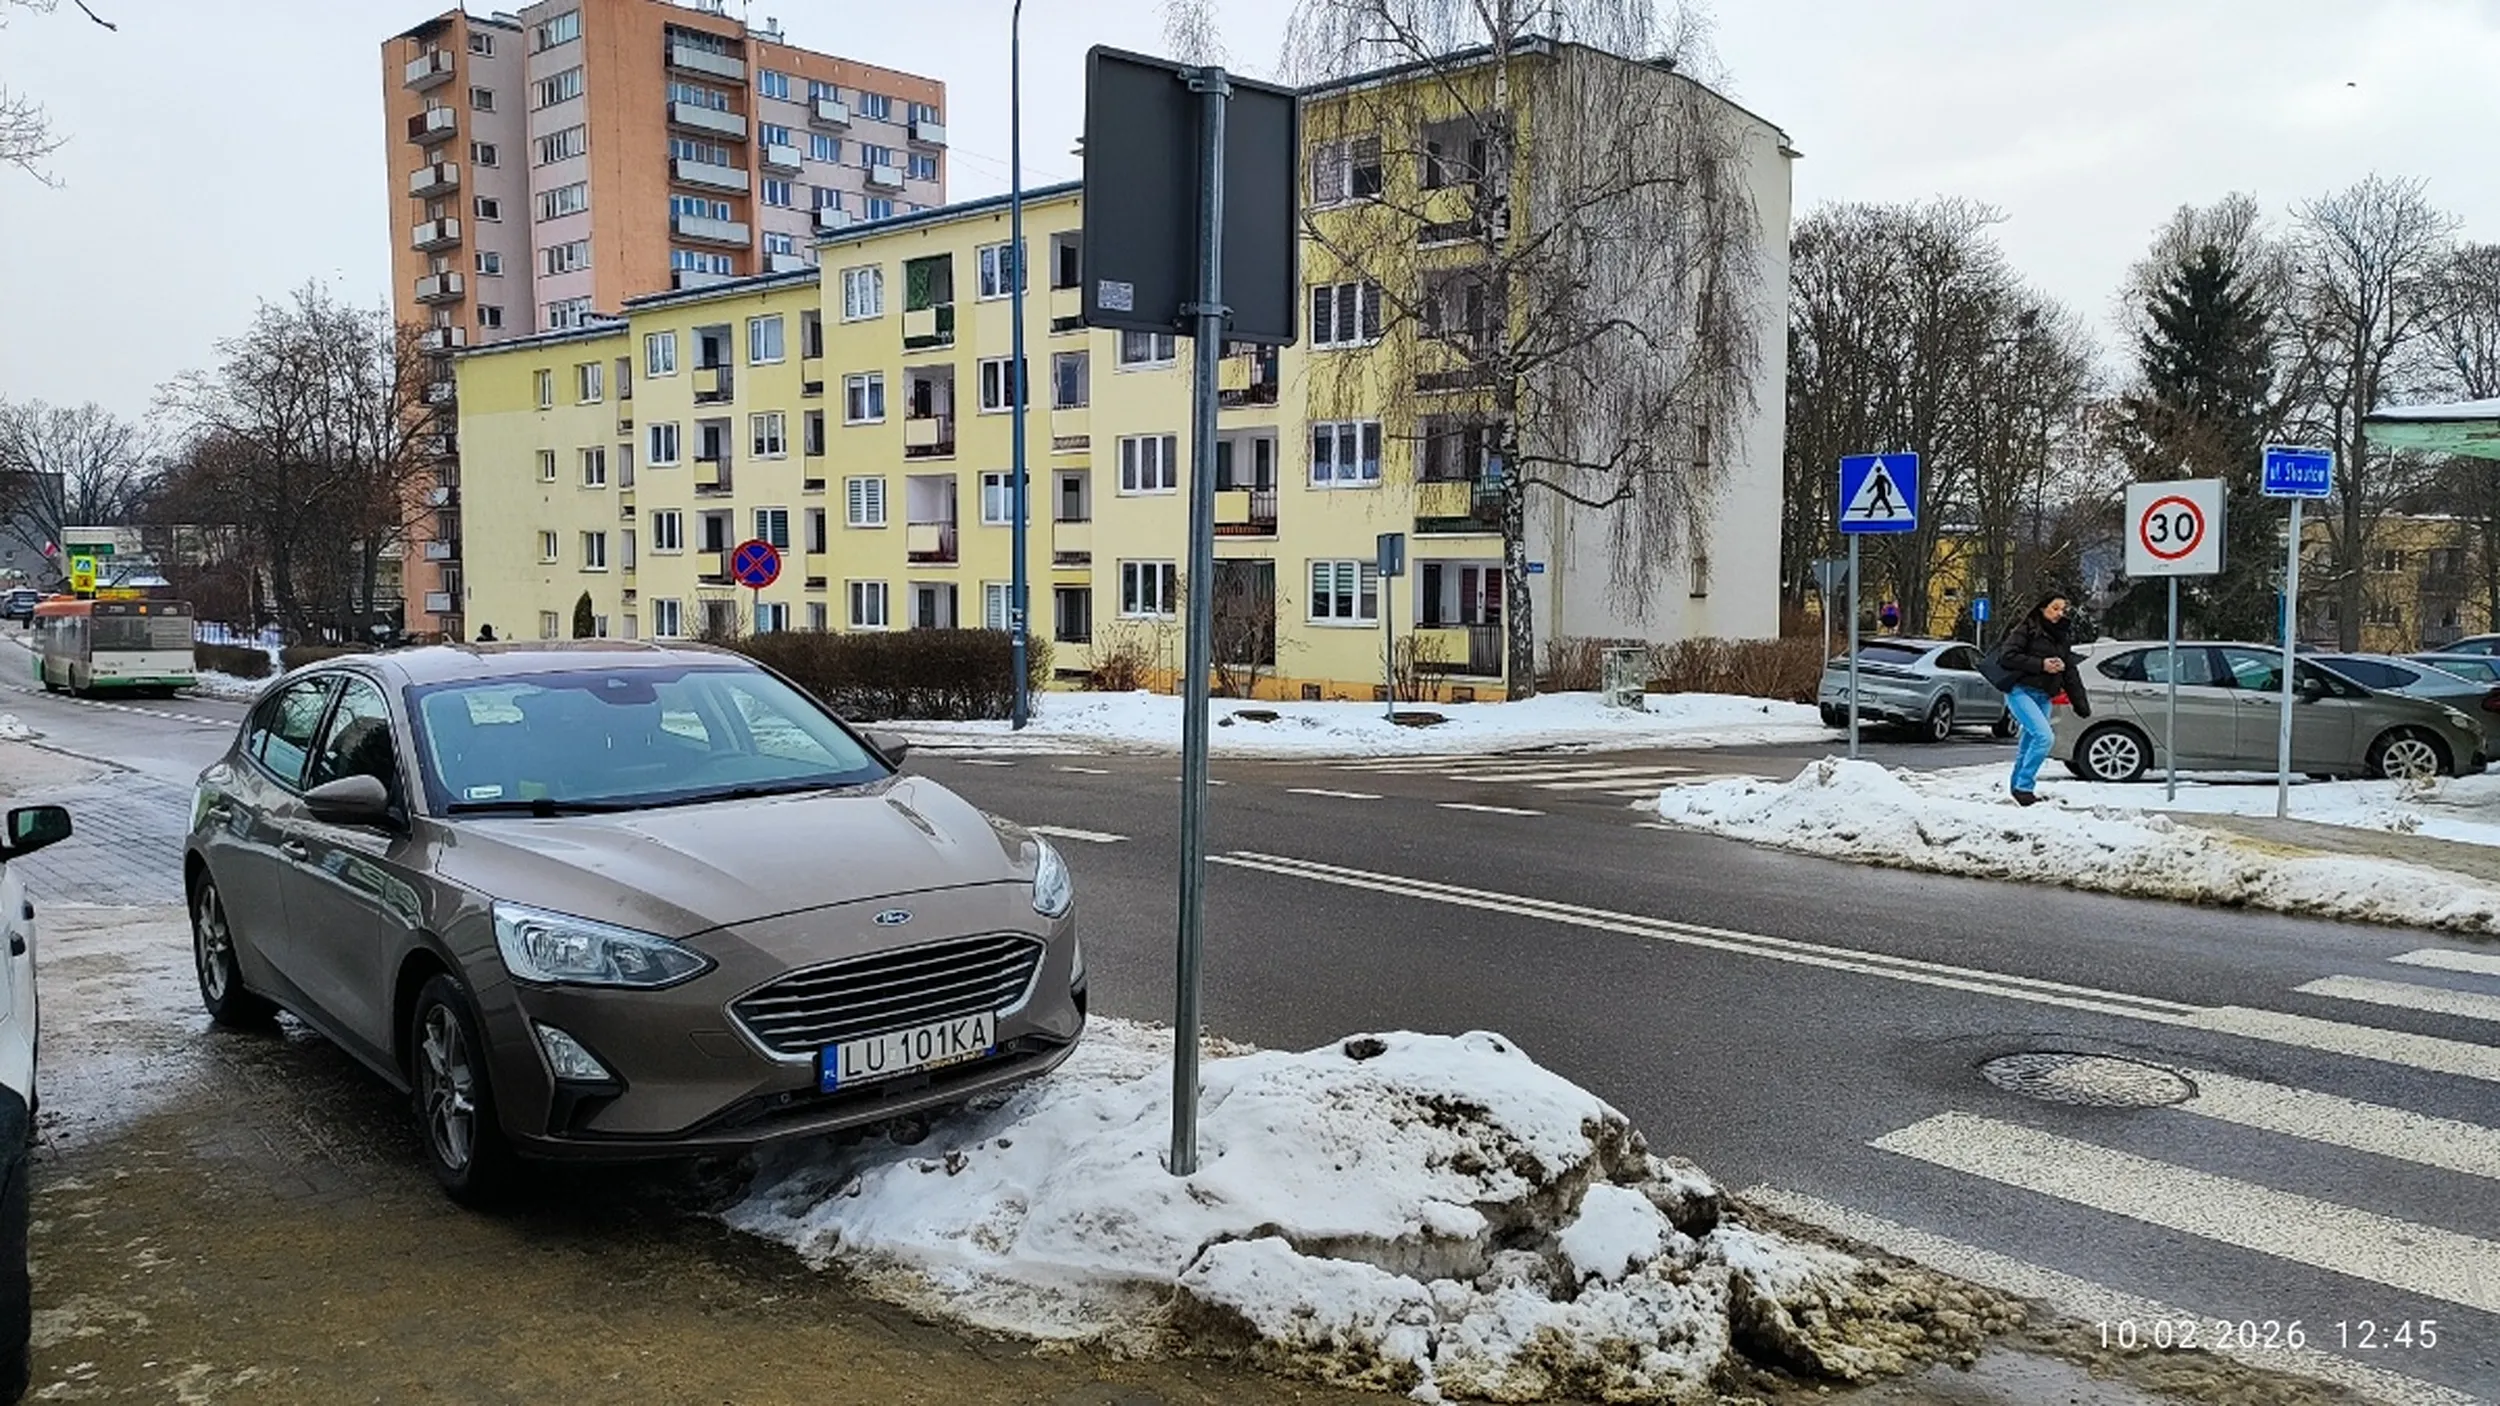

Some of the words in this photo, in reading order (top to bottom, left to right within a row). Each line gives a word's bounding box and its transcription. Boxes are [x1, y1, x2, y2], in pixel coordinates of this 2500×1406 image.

[2150, 512, 2195, 543] 30
[845, 1039, 885, 1077] LU
[901, 1017, 987, 1064] 101KA
